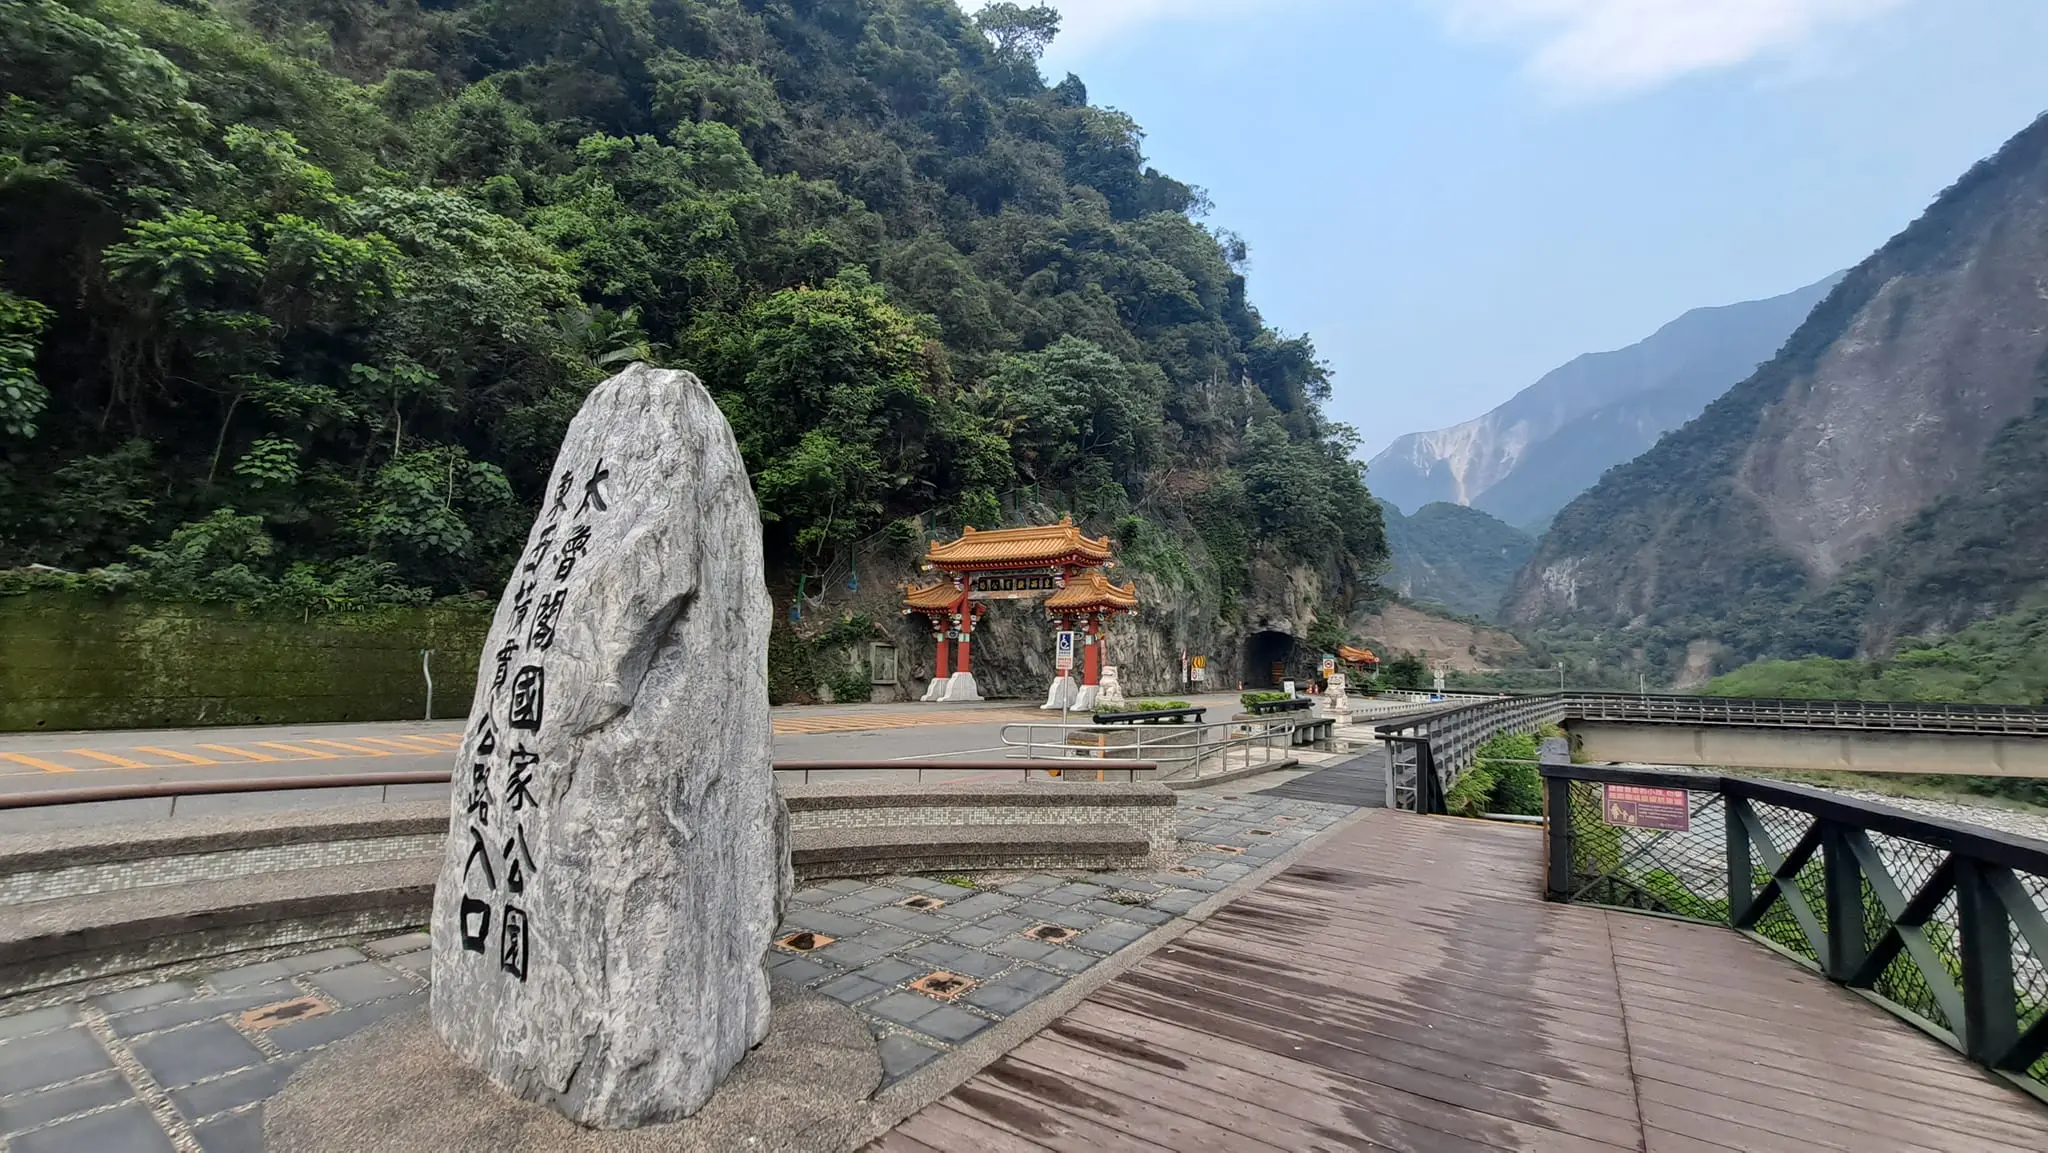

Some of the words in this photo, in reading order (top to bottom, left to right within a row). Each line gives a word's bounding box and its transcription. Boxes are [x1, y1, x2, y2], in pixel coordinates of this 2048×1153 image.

[501, 458, 609, 983] 太魯閣國家公園
